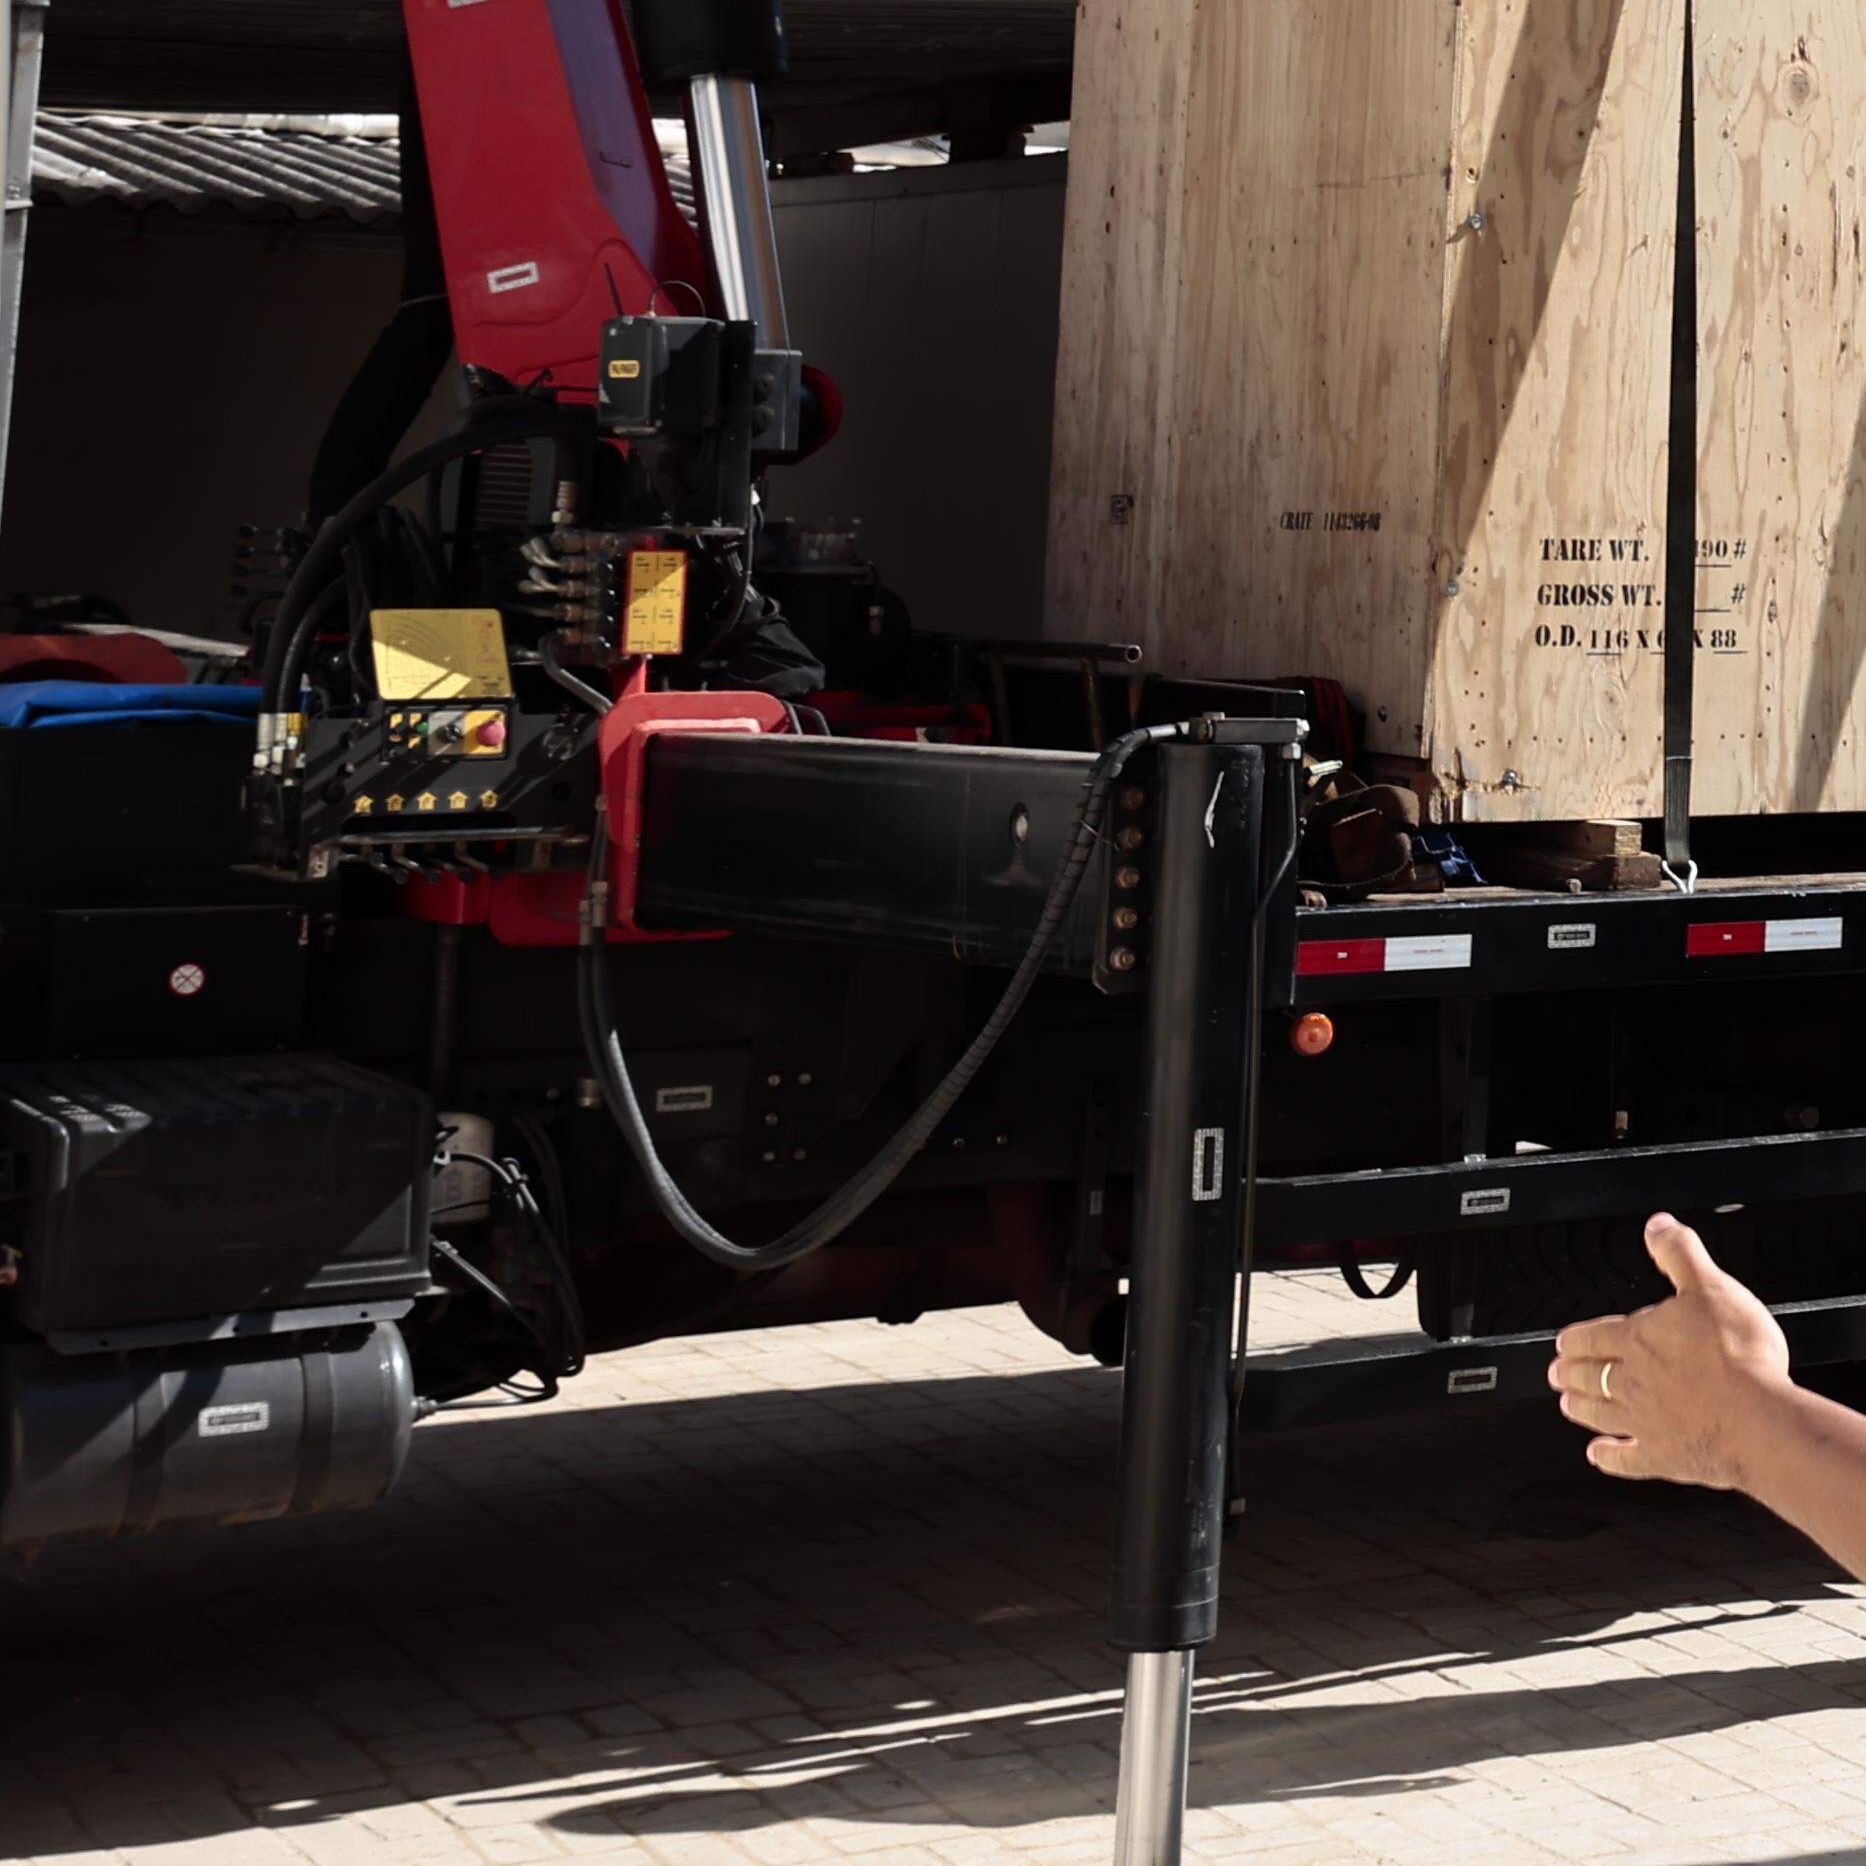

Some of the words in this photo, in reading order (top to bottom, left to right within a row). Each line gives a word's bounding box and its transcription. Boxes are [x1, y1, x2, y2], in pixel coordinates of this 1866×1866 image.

[1539, 538, 1602, 562] TARE
[1608, 539, 1650, 562] WT.
[1536, 584, 1614, 607] GROSS
[1621, 584, 1662, 607] WT.
[1534, 624, 1582, 647] O.D.
[1589, 629, 1629, 649] 116
[1635, 629, 1650, 649] X
[1710, 629, 1737, 649] 88
